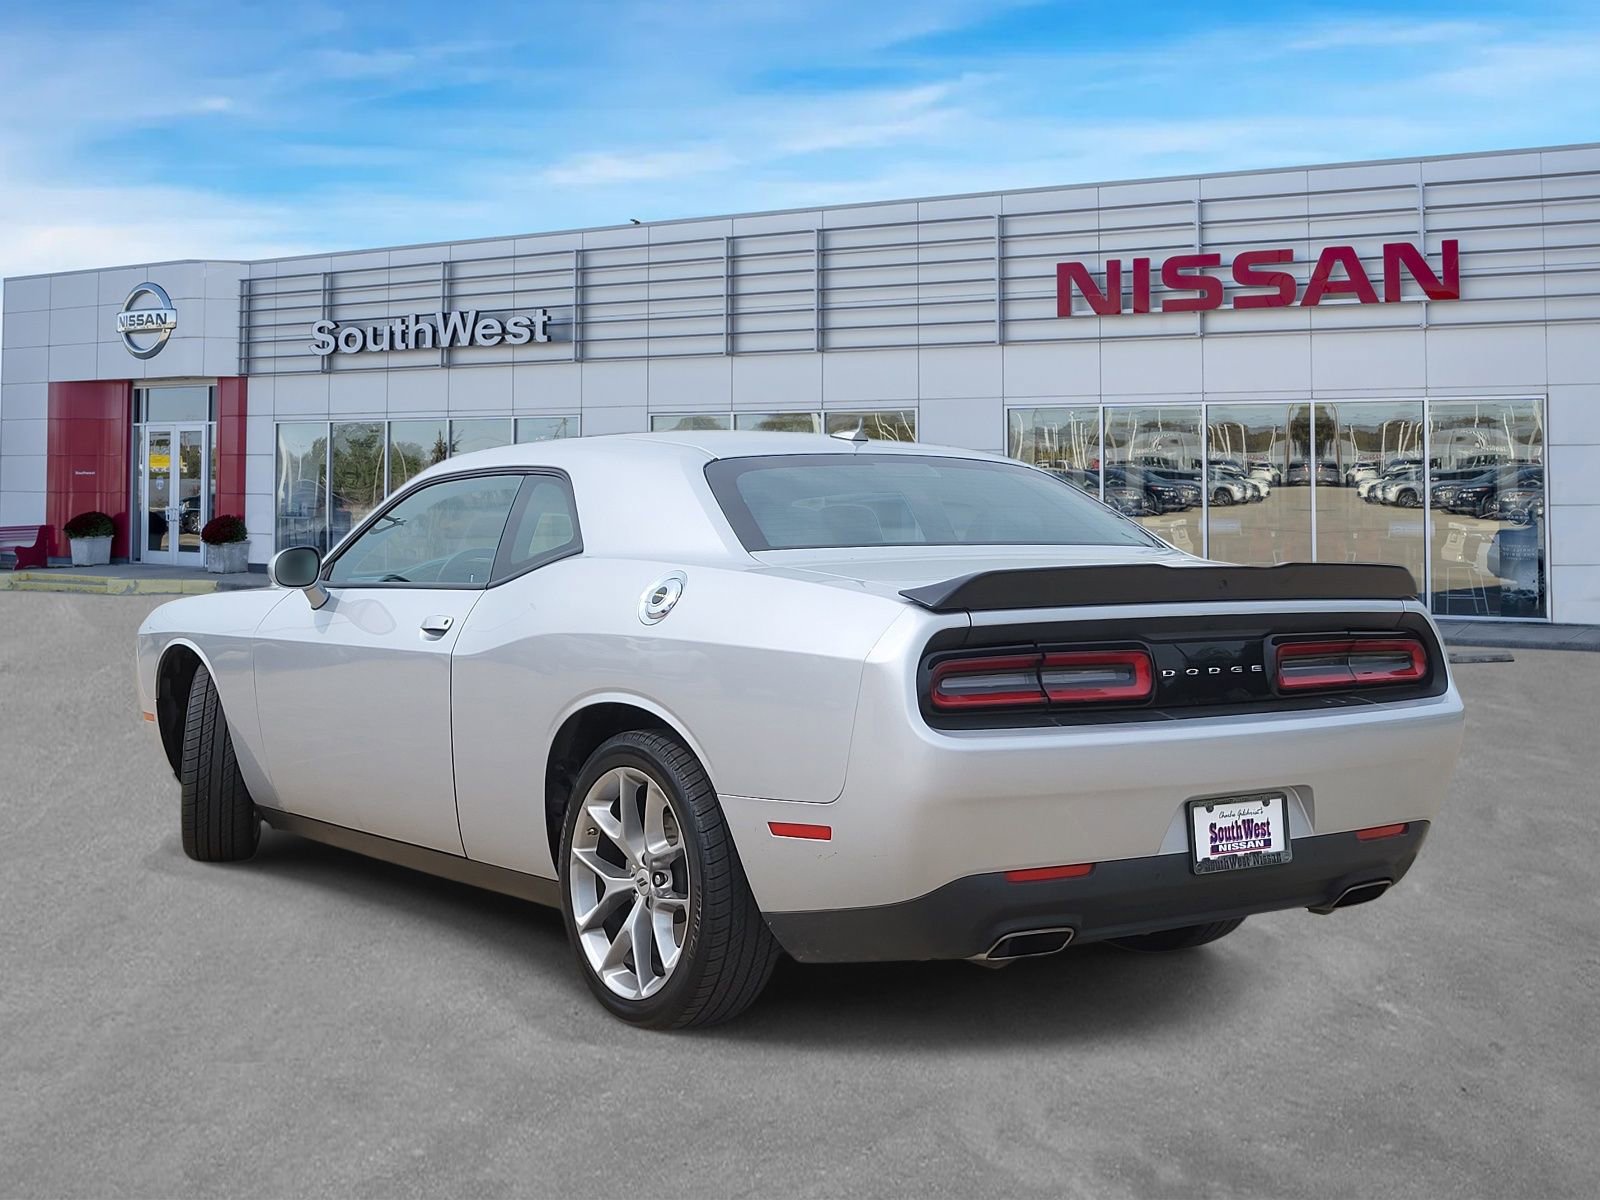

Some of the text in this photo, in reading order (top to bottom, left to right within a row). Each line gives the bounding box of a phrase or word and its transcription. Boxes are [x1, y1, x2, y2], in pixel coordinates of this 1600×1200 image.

[1057, 240, 1460, 317] NISSAN
[119, 312, 167, 328] NISSAN
[309, 309, 551, 355] SouthWest
[1162, 664, 1263, 677] DODGE
[1209, 817, 1271, 844] SouthWest
[1218, 840, 1264, 852] NISSAN
